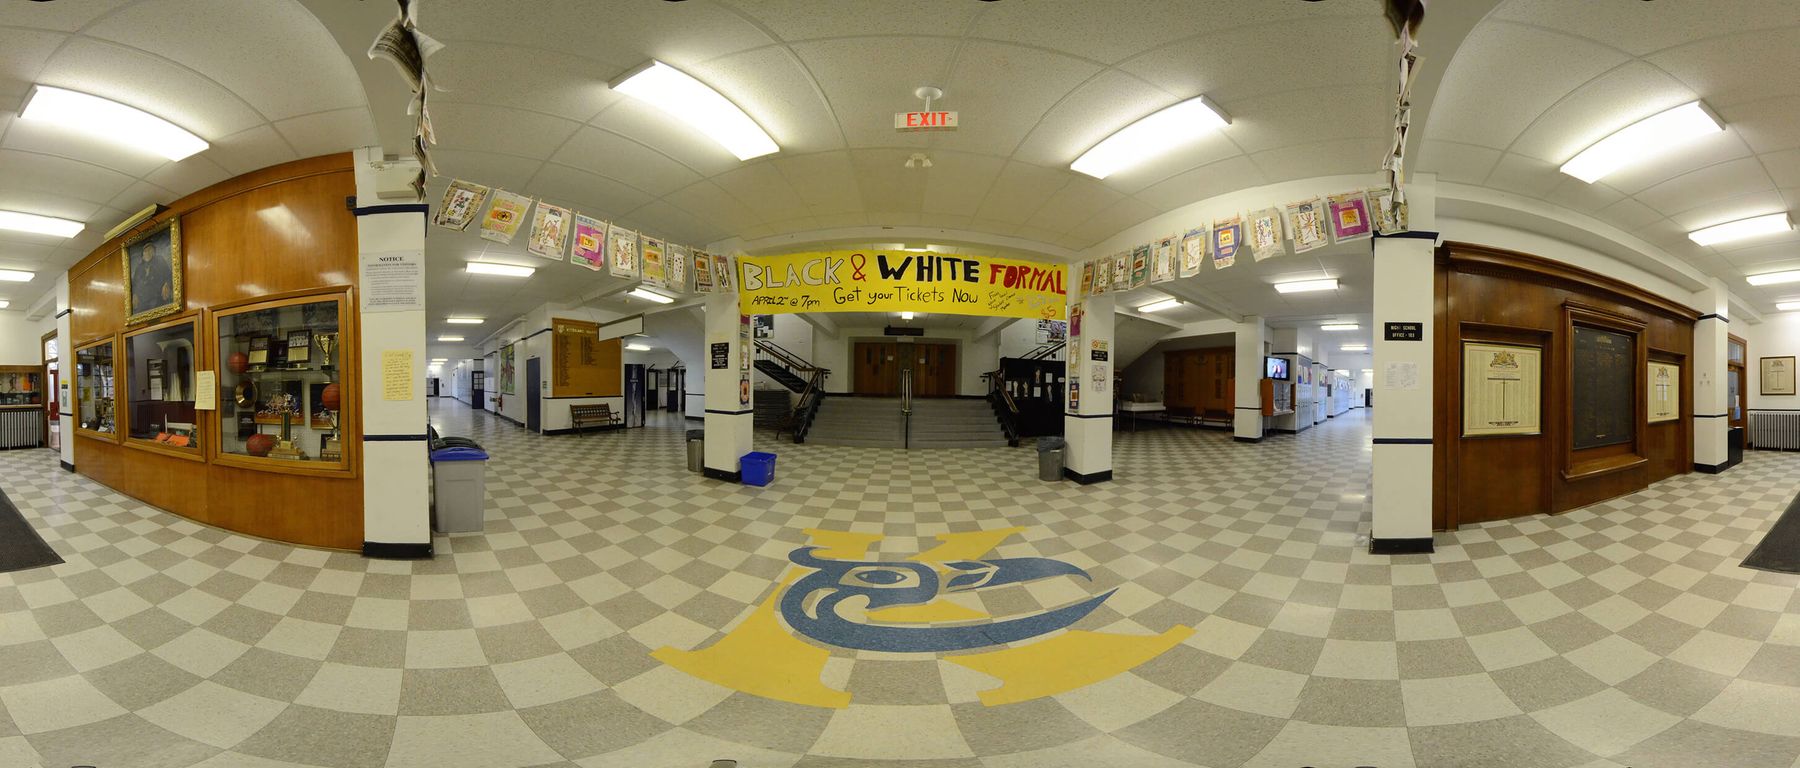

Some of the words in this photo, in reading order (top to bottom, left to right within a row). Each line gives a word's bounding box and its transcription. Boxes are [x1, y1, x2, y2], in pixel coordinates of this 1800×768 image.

[906, 112, 949, 127] EXIT
[743, 256, 844, 291] BLACK
[850, 253, 866, 282] &
[877, 254, 980, 283] WHITE
[990, 264, 1066, 295] FORMAL
[790, 298, 799, 306] @
[801, 295, 820, 310] 7pm
[833, 286, 862, 304] Get
[867, 290, 893, 305] your
[894, 286, 945, 303] Tickets
[952, 287, 978, 303] Now
